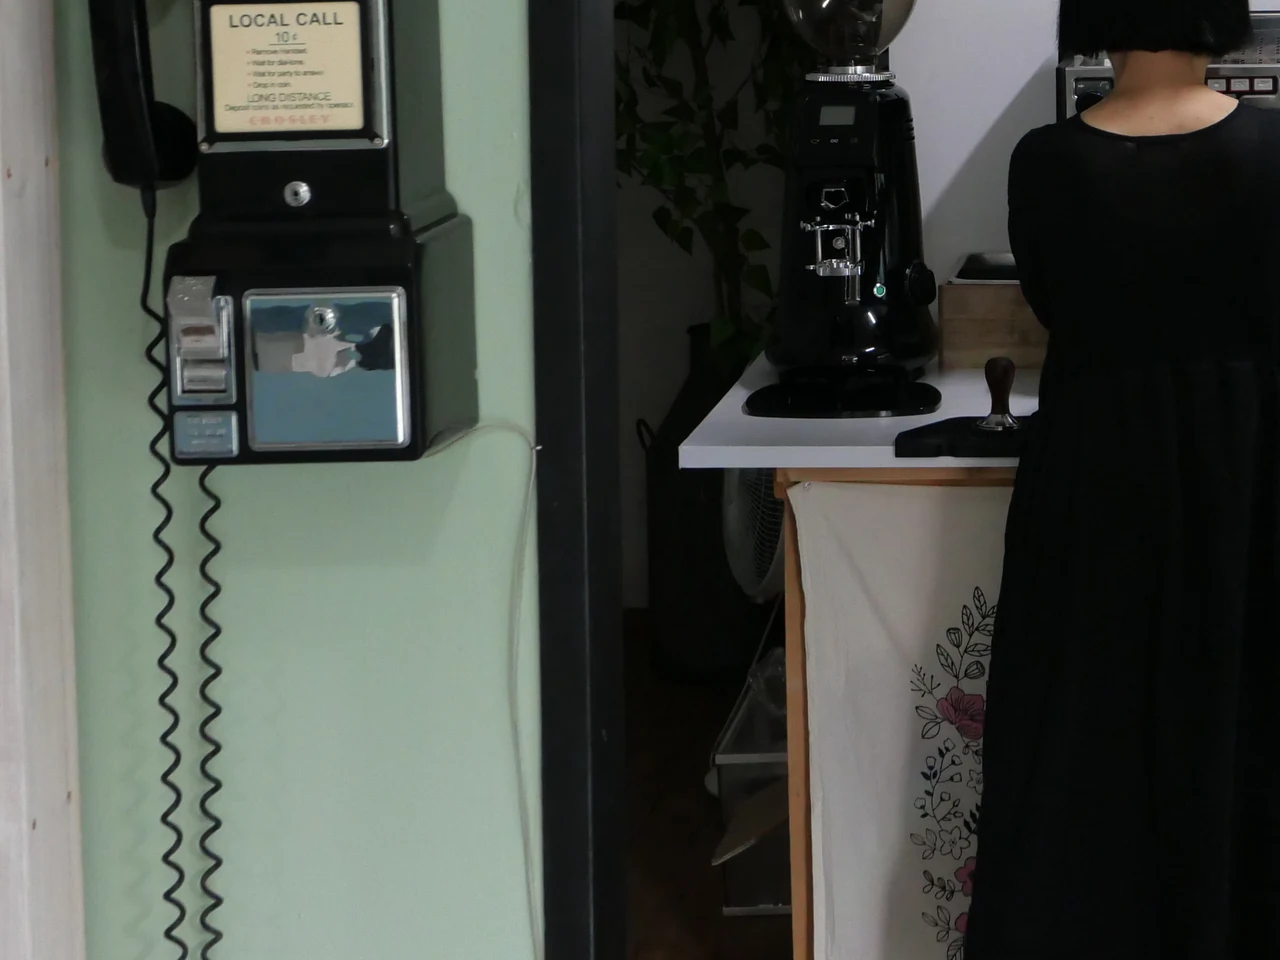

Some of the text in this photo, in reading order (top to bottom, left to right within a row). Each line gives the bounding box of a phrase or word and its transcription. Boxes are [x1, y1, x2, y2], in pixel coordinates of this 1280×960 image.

[228, 11, 345, 28] LOCAL CALL
[246, 91, 332, 102] LONG DISTANCE
[248, 114, 332, 126] CROSLEY
